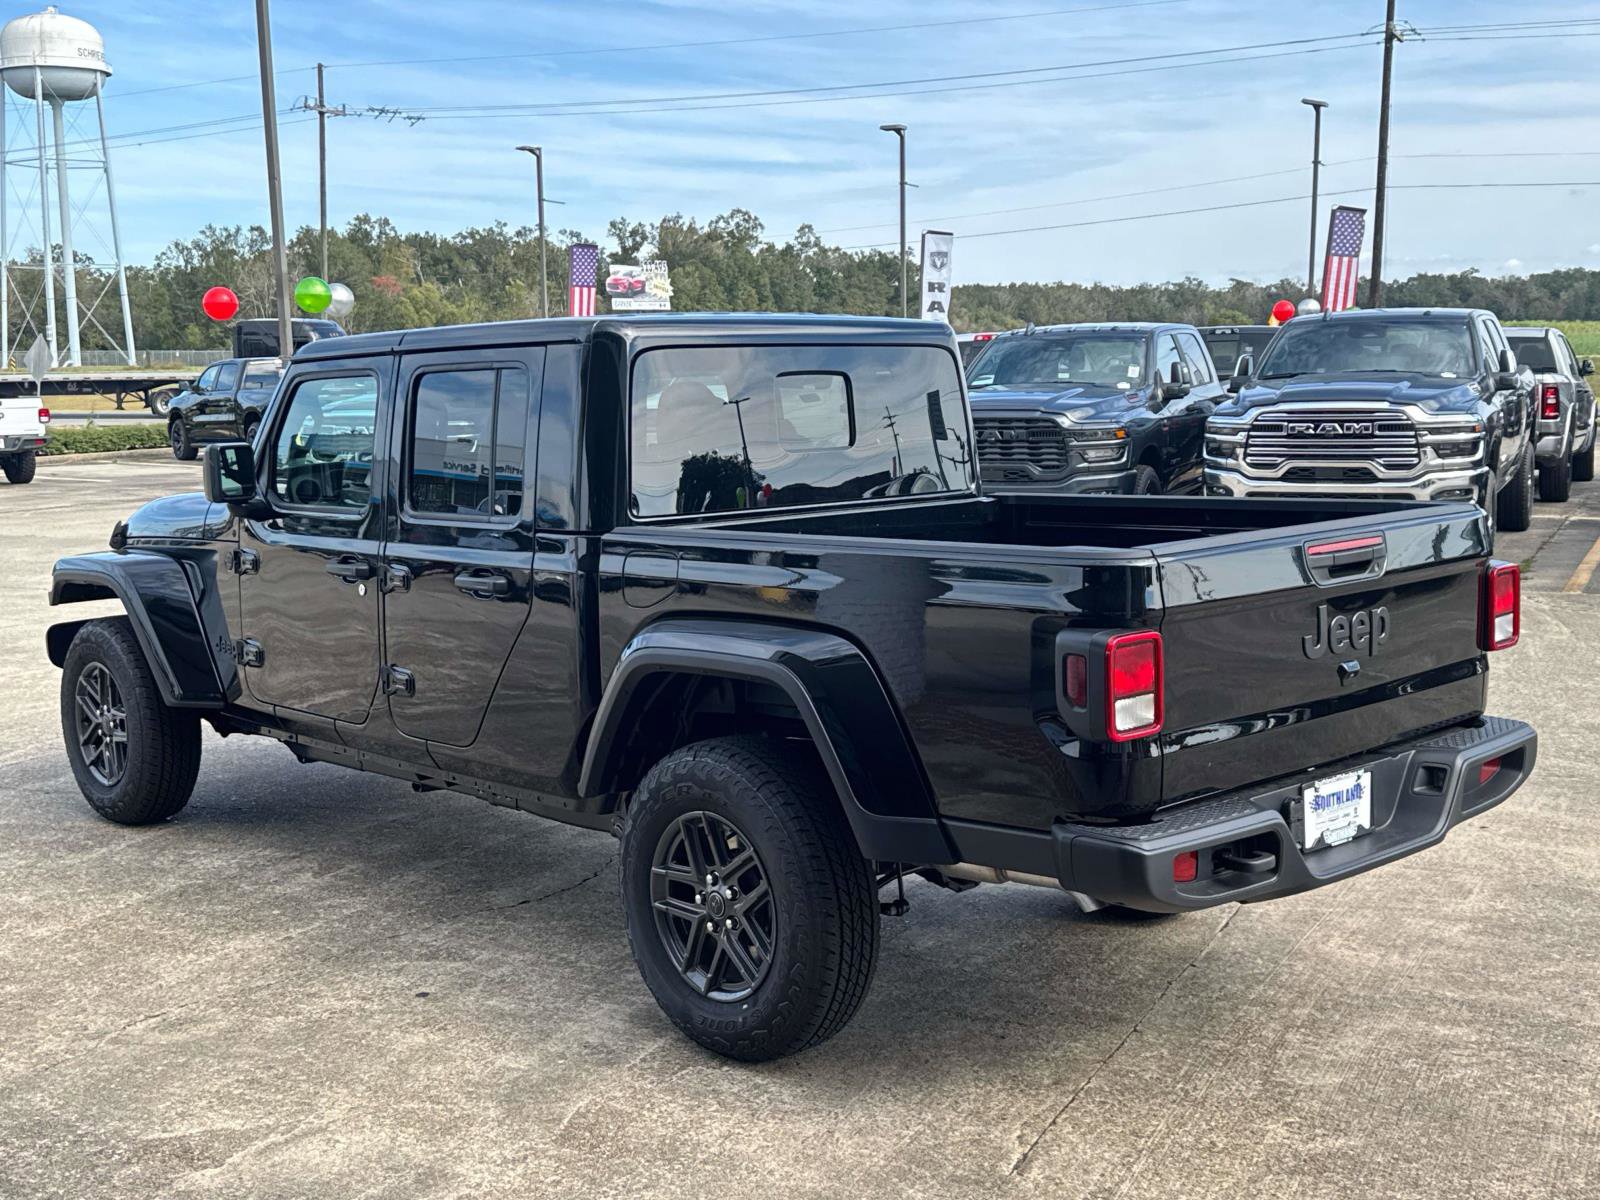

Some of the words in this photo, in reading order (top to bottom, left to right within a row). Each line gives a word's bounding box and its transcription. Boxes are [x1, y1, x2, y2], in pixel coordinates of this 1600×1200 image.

[1287, 422, 1373, 435] RAM
[1302, 604, 1391, 659] Jeep
[1314, 783, 1363, 812] SOUTHLAND
